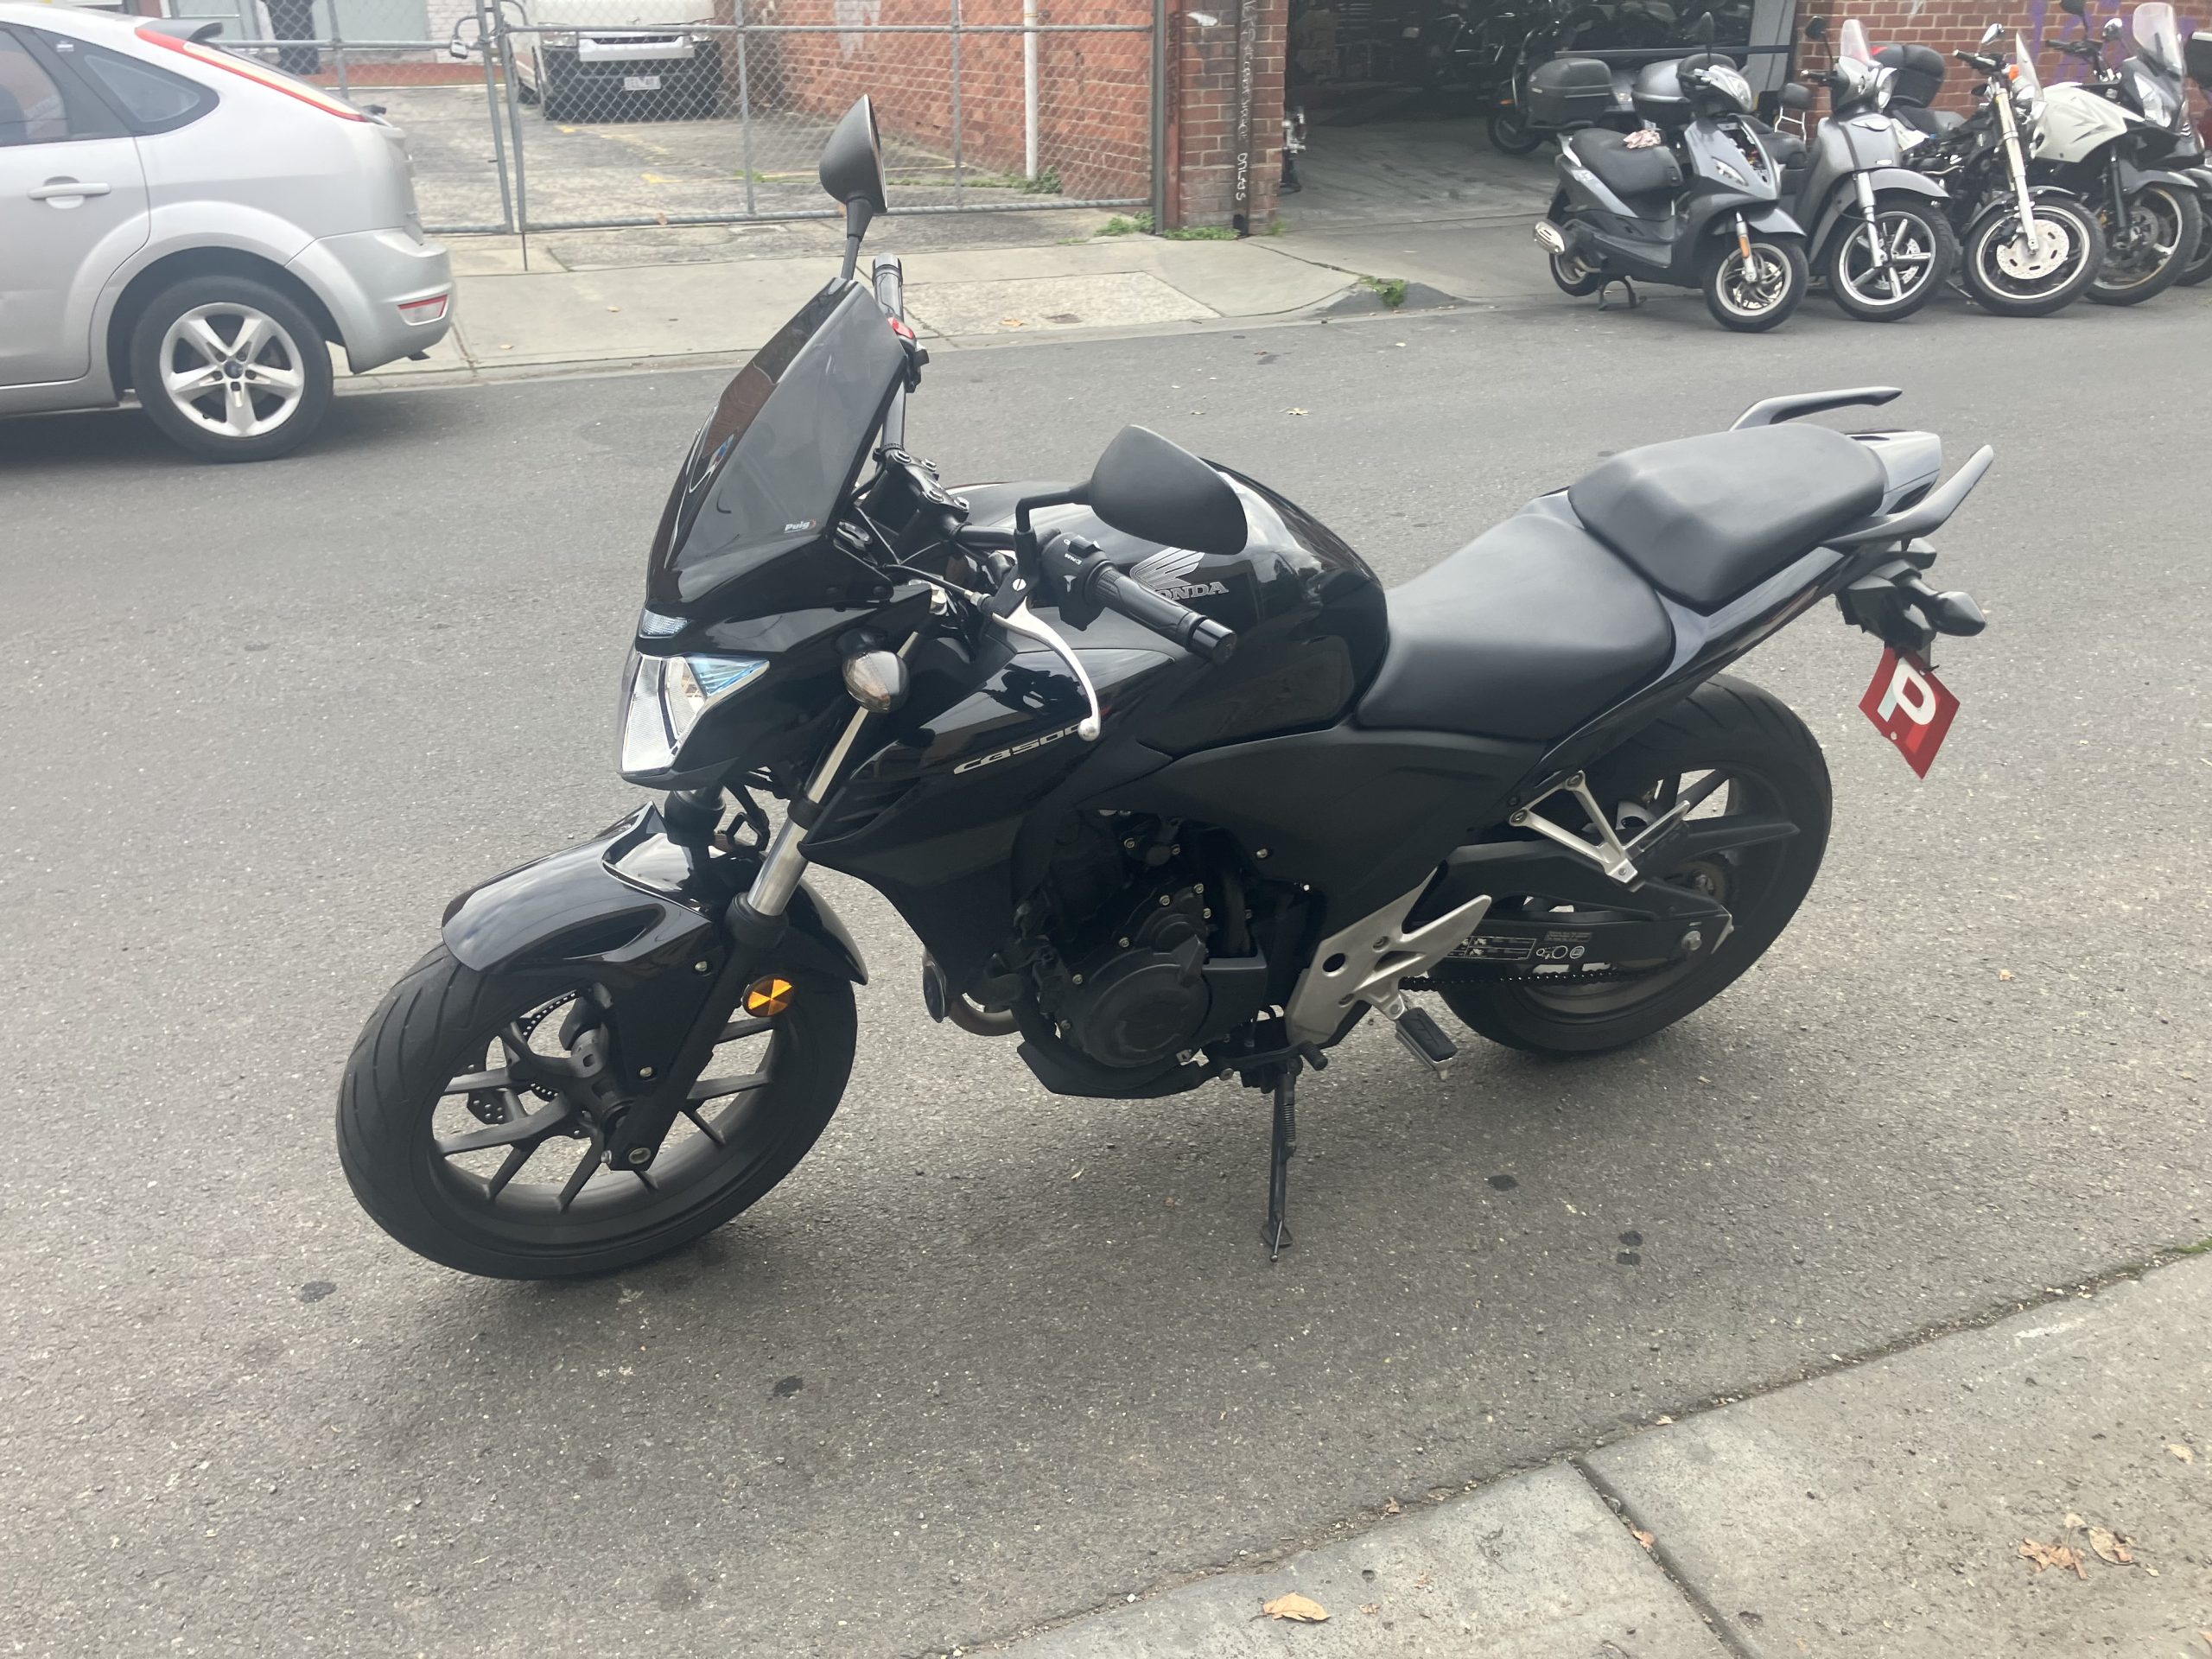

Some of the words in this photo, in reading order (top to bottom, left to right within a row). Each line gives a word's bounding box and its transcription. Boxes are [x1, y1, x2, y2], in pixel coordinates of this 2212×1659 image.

[785, 521, 810, 531] Puig
[1155, 582, 1229, 601] ONDA
[1877, 656, 1936, 726] P
